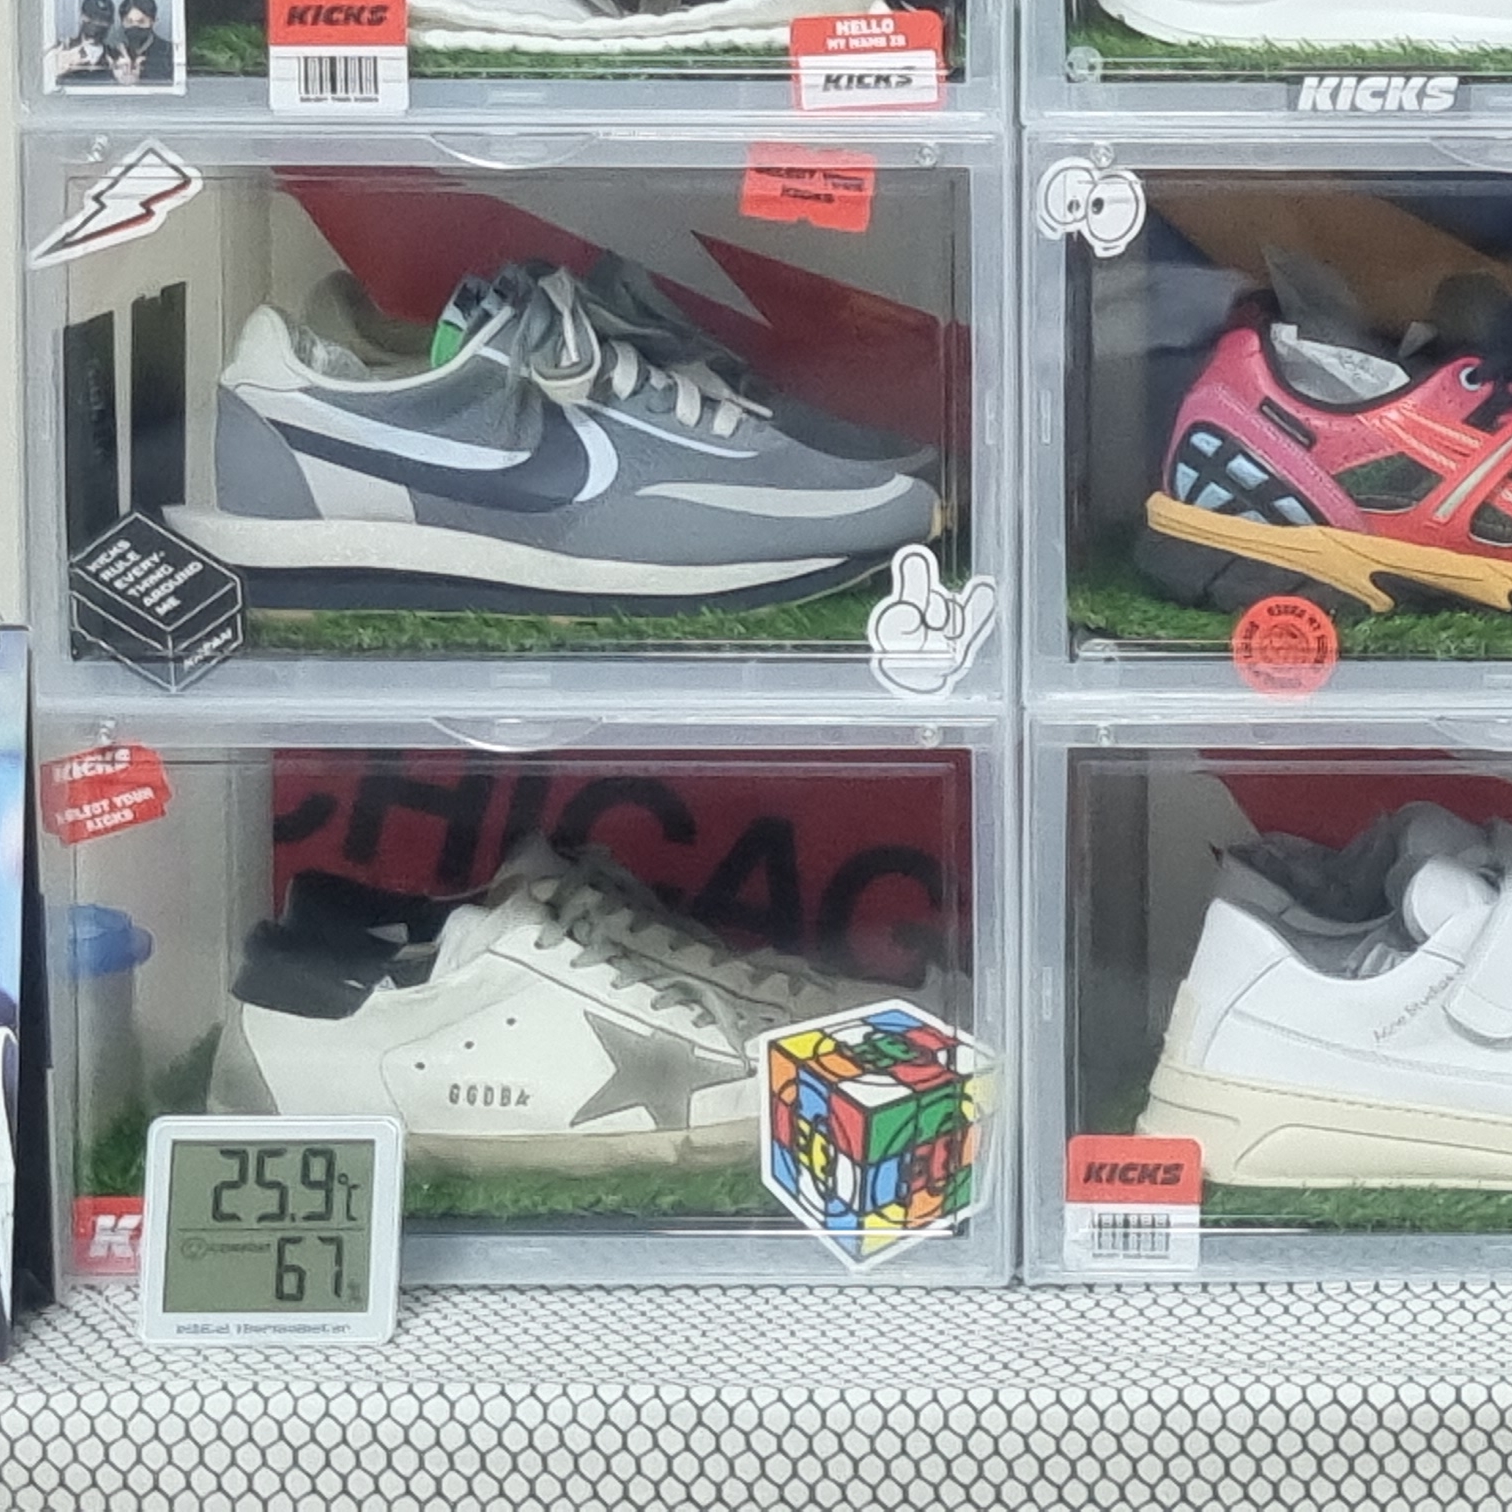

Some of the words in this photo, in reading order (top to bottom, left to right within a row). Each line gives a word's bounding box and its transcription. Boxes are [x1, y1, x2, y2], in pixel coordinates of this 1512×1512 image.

[286, 3, 390, 27] KICKS
[835, 18, 895, 36] HELLO
[822, 65, 916, 93] KICKS
[1297, 76, 1460, 113] KICKS
[1083, 1161, 1185, 1186] KICKS
[275, 1235, 344, 1302] 67
